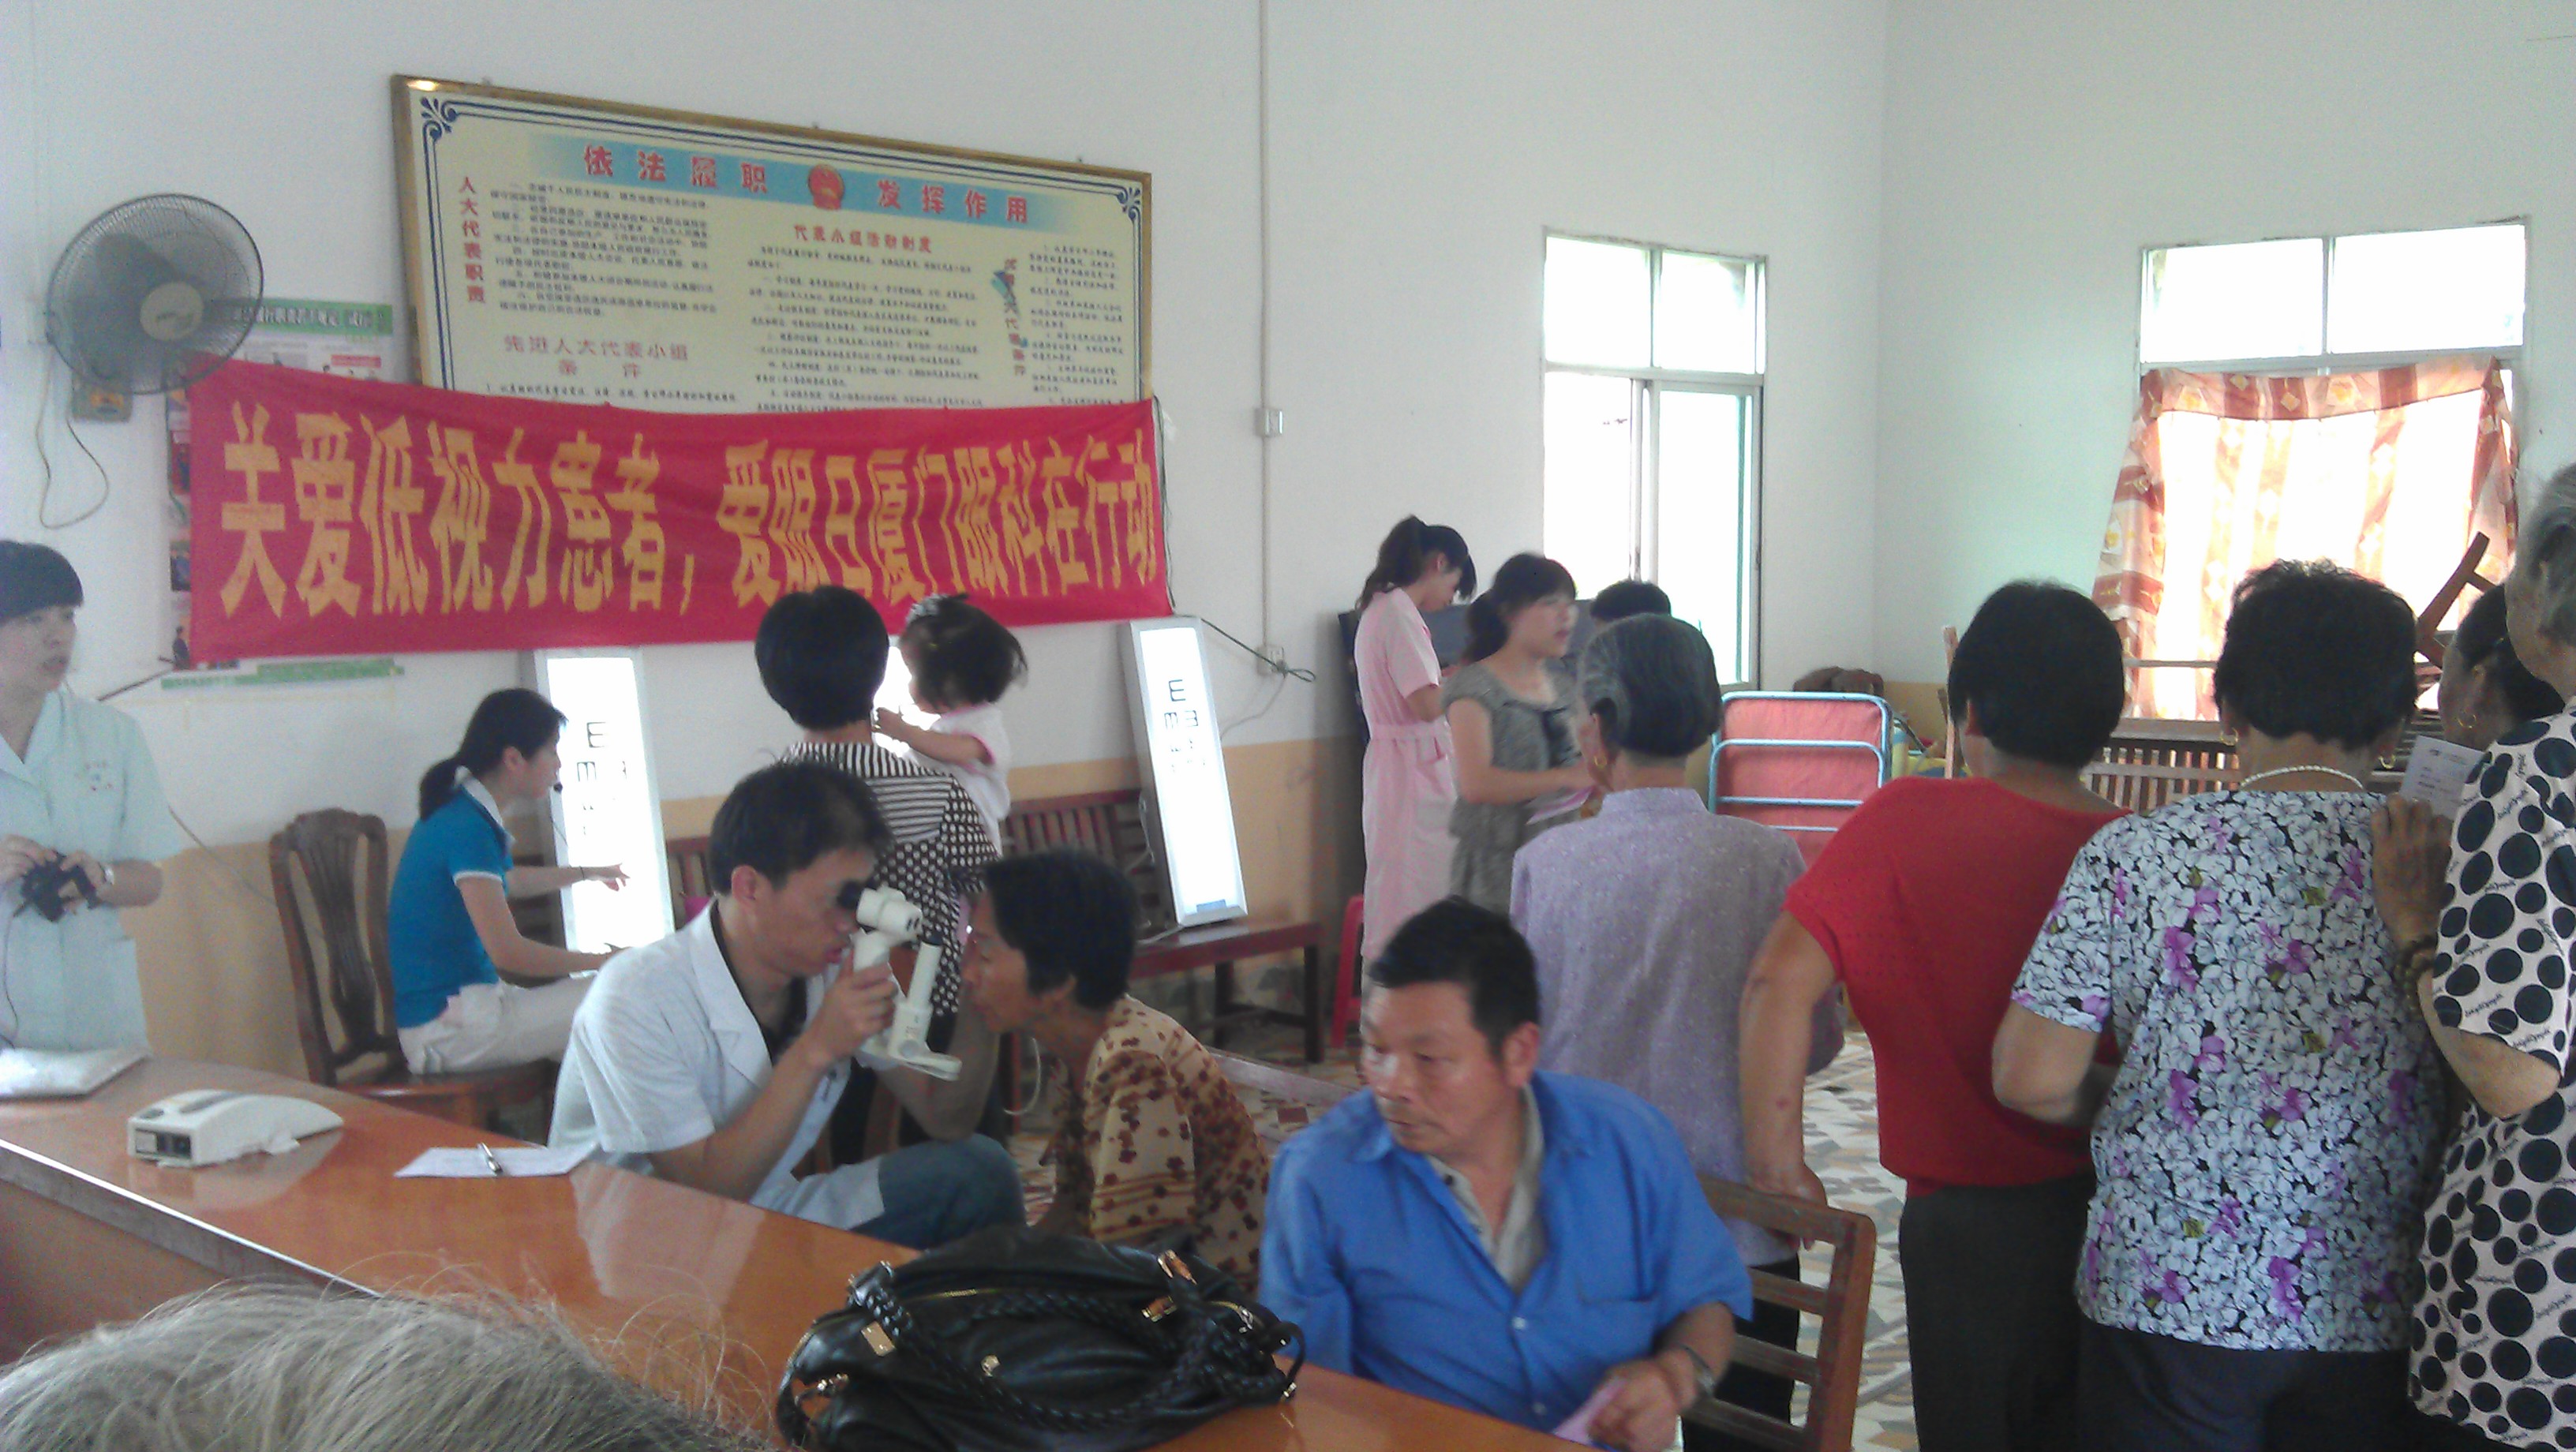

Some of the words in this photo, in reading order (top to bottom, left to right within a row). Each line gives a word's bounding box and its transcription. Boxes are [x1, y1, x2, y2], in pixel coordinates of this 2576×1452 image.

[584, 144, 768, 194] 依法履职
[878, 178, 1028, 223] 发挥作用
